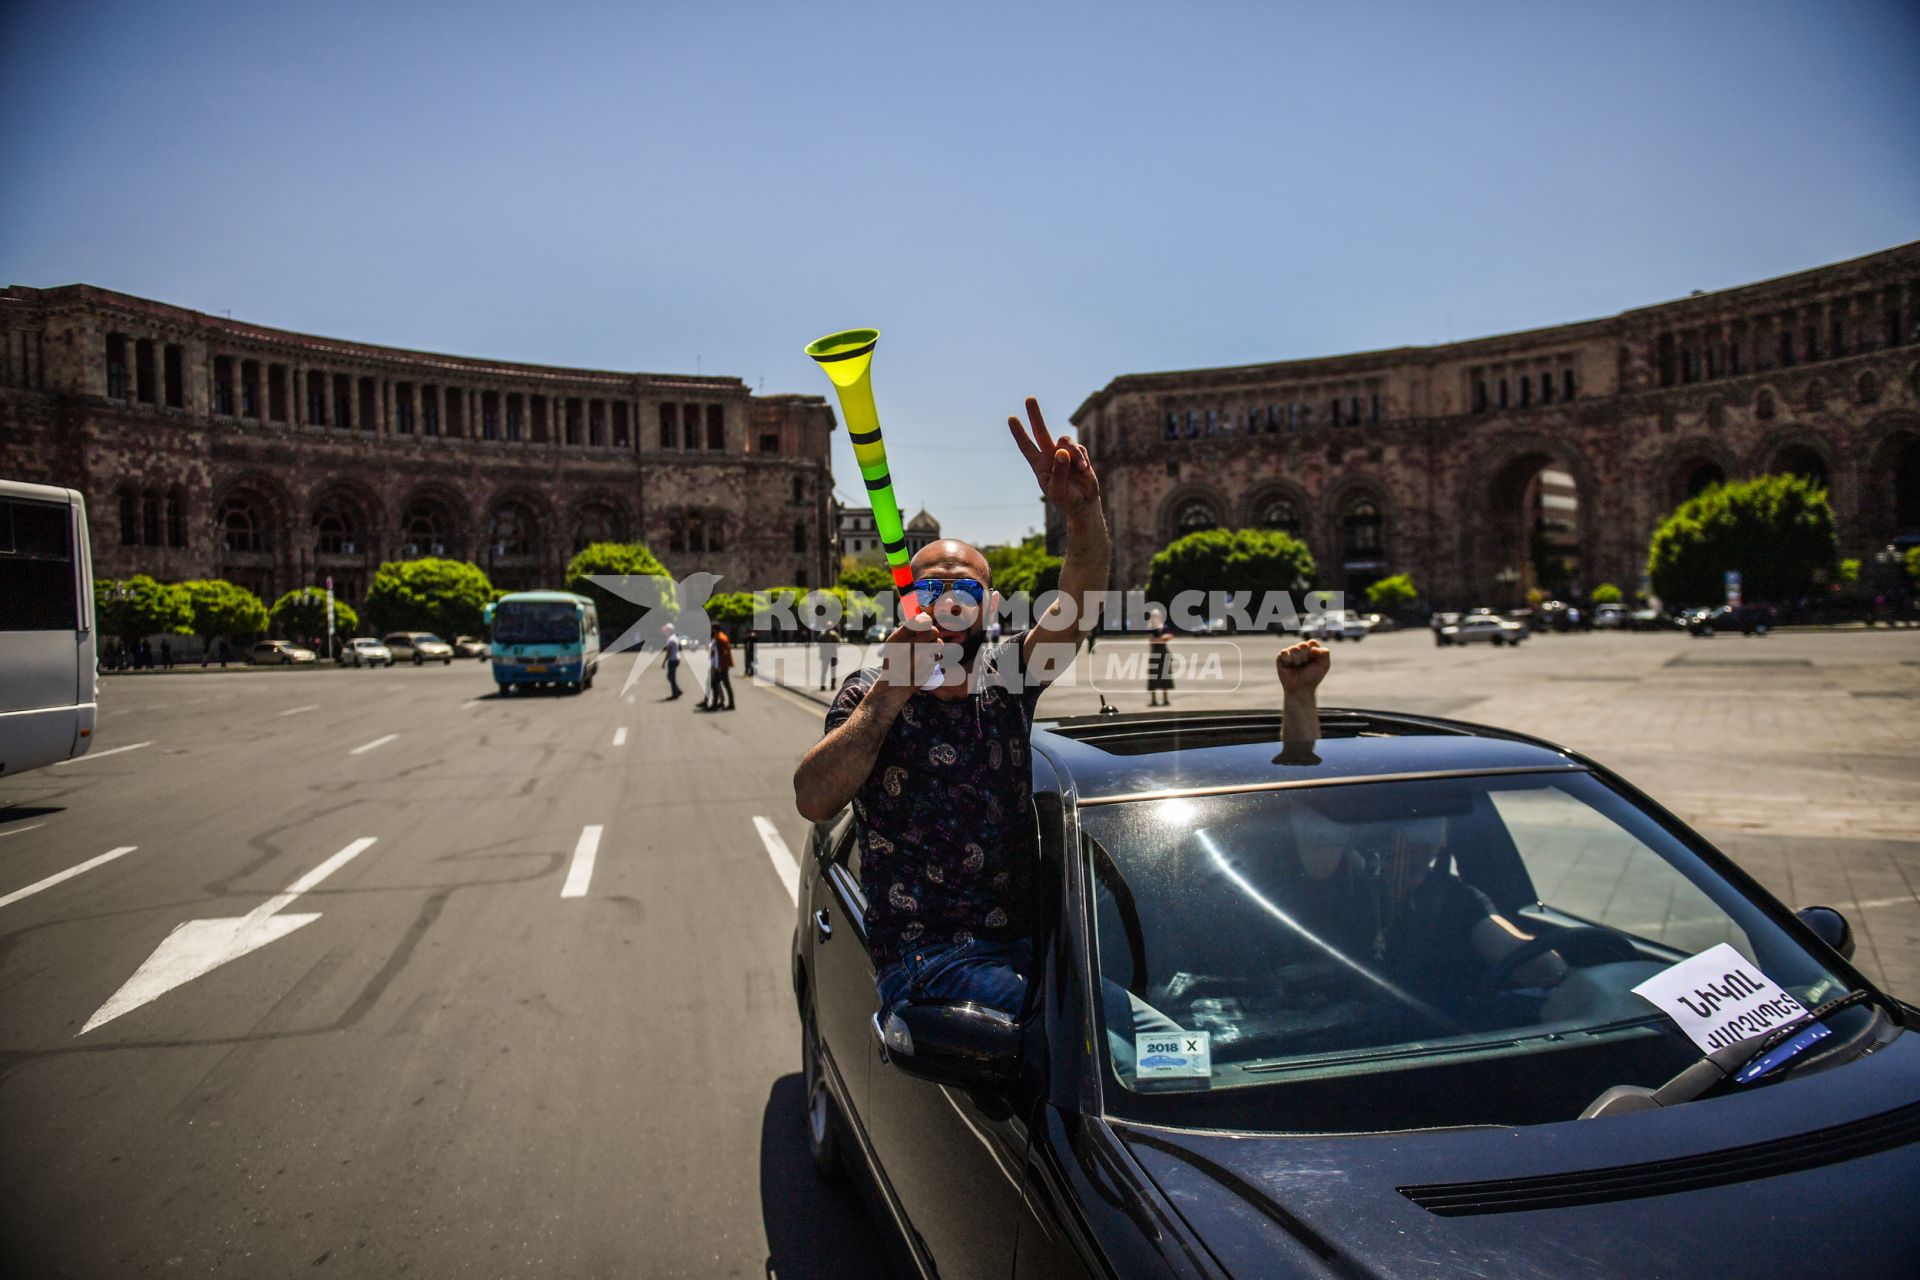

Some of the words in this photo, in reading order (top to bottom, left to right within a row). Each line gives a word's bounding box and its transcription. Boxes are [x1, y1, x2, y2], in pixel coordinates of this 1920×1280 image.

[1677, 969, 1766, 1018] ՆԻԿՈԼ
[1147, 1043, 1178, 1053] 2018
[1186, 1040, 1197, 1052] X
